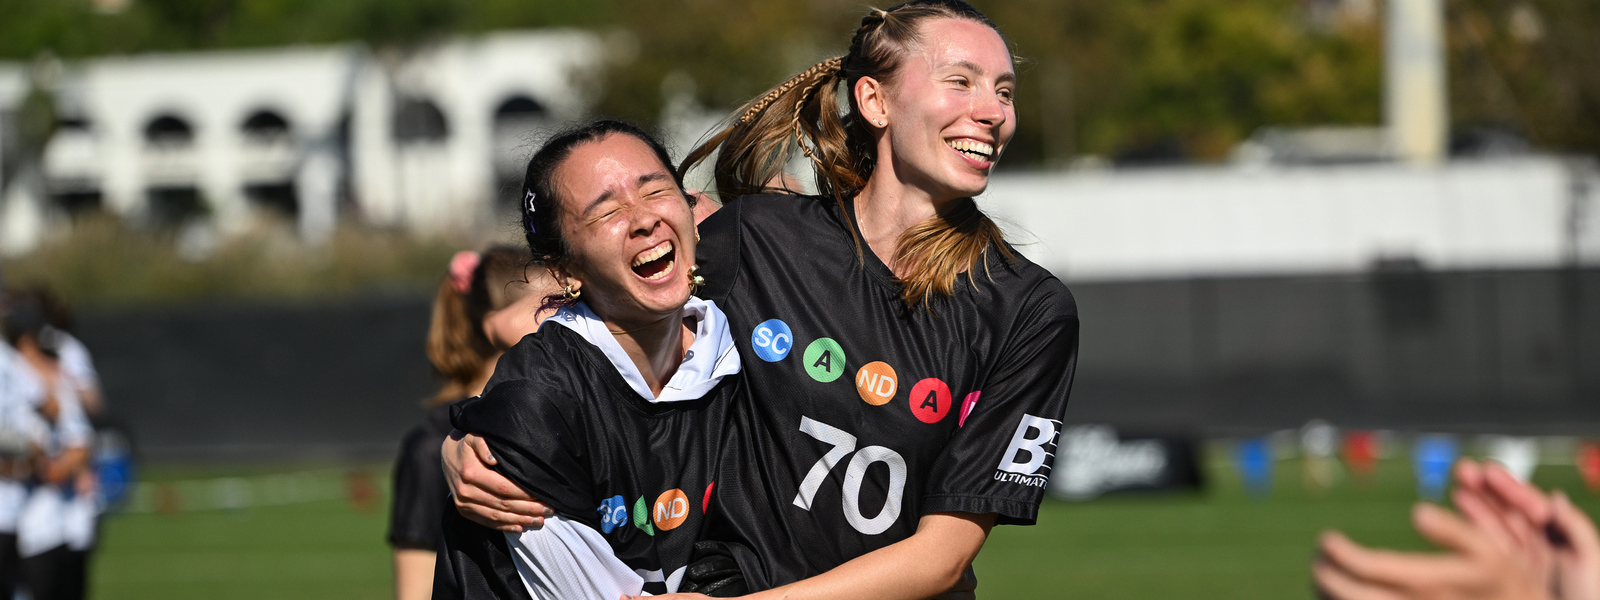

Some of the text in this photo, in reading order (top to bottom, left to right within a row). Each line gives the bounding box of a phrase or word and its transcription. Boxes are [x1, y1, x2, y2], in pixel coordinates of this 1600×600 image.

[754, 326, 790, 355] SC
[812, 349, 832, 373] A
[858, 369, 896, 398] ND
[919, 389, 938, 413] A
[656, 497, 687, 523] ND
[792, 415, 908, 536] 70
